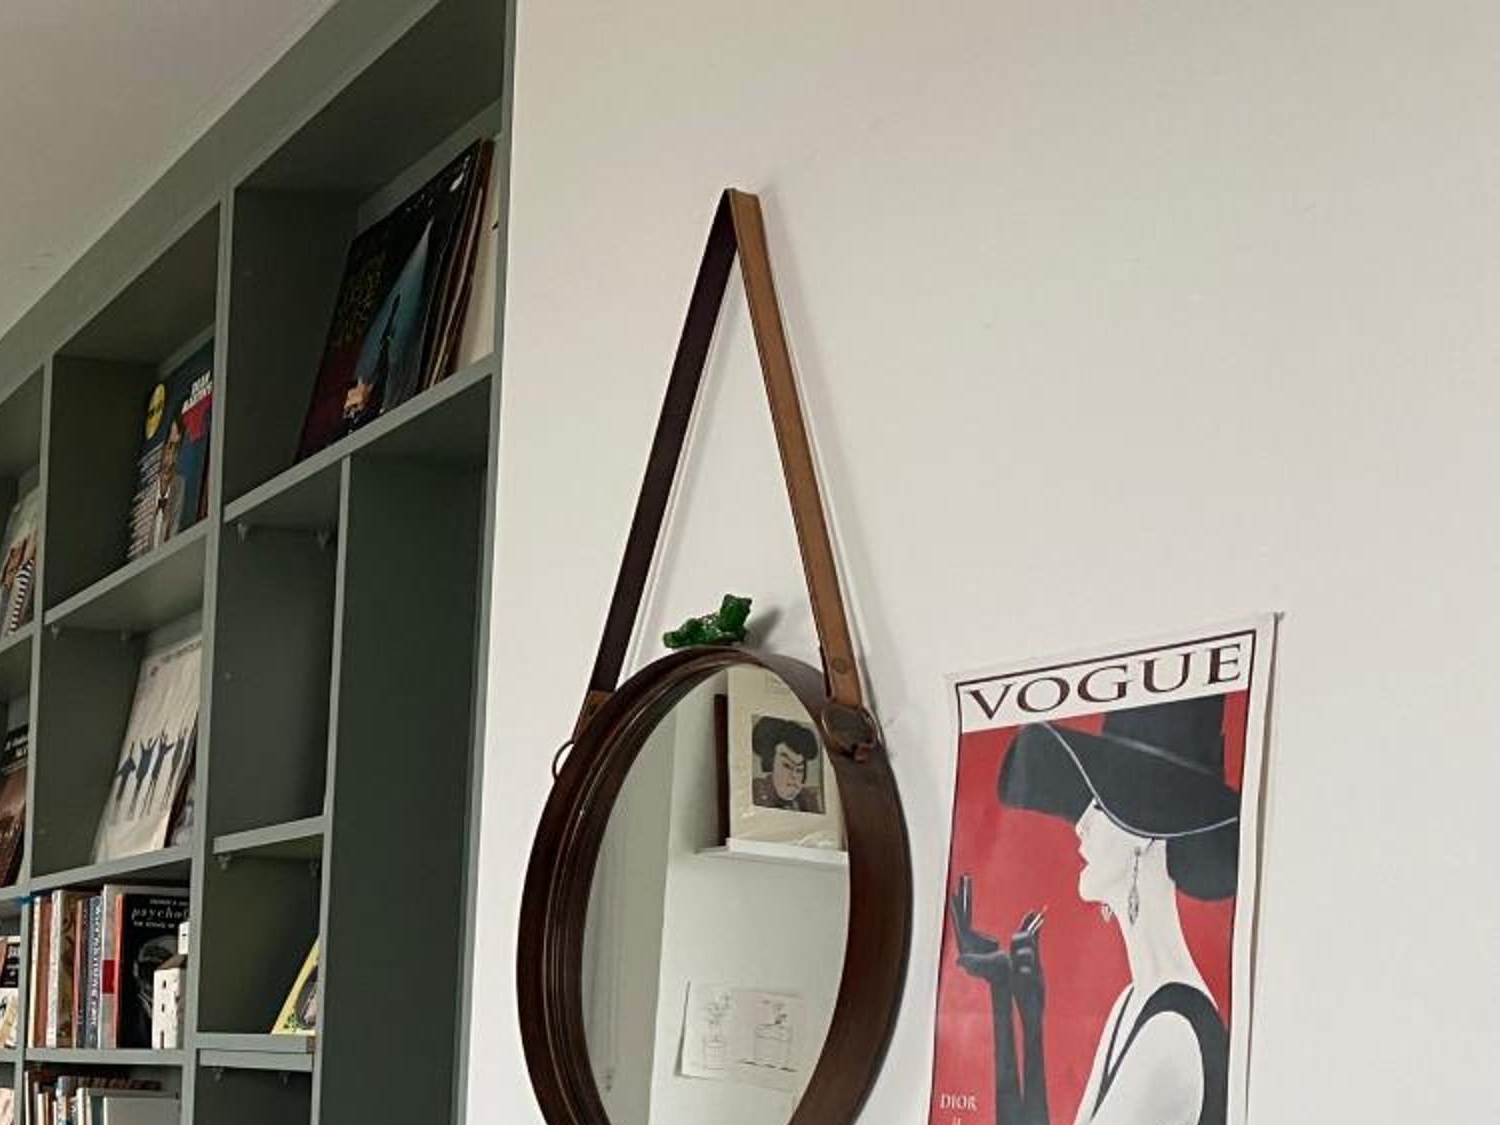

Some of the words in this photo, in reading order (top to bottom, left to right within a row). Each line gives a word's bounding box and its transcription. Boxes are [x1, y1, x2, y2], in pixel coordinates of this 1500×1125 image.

[969, 643, 1241, 720] VOGUE
[131, 906, 189, 921] psychol
[940, 1093, 977, 1111] DIOR
